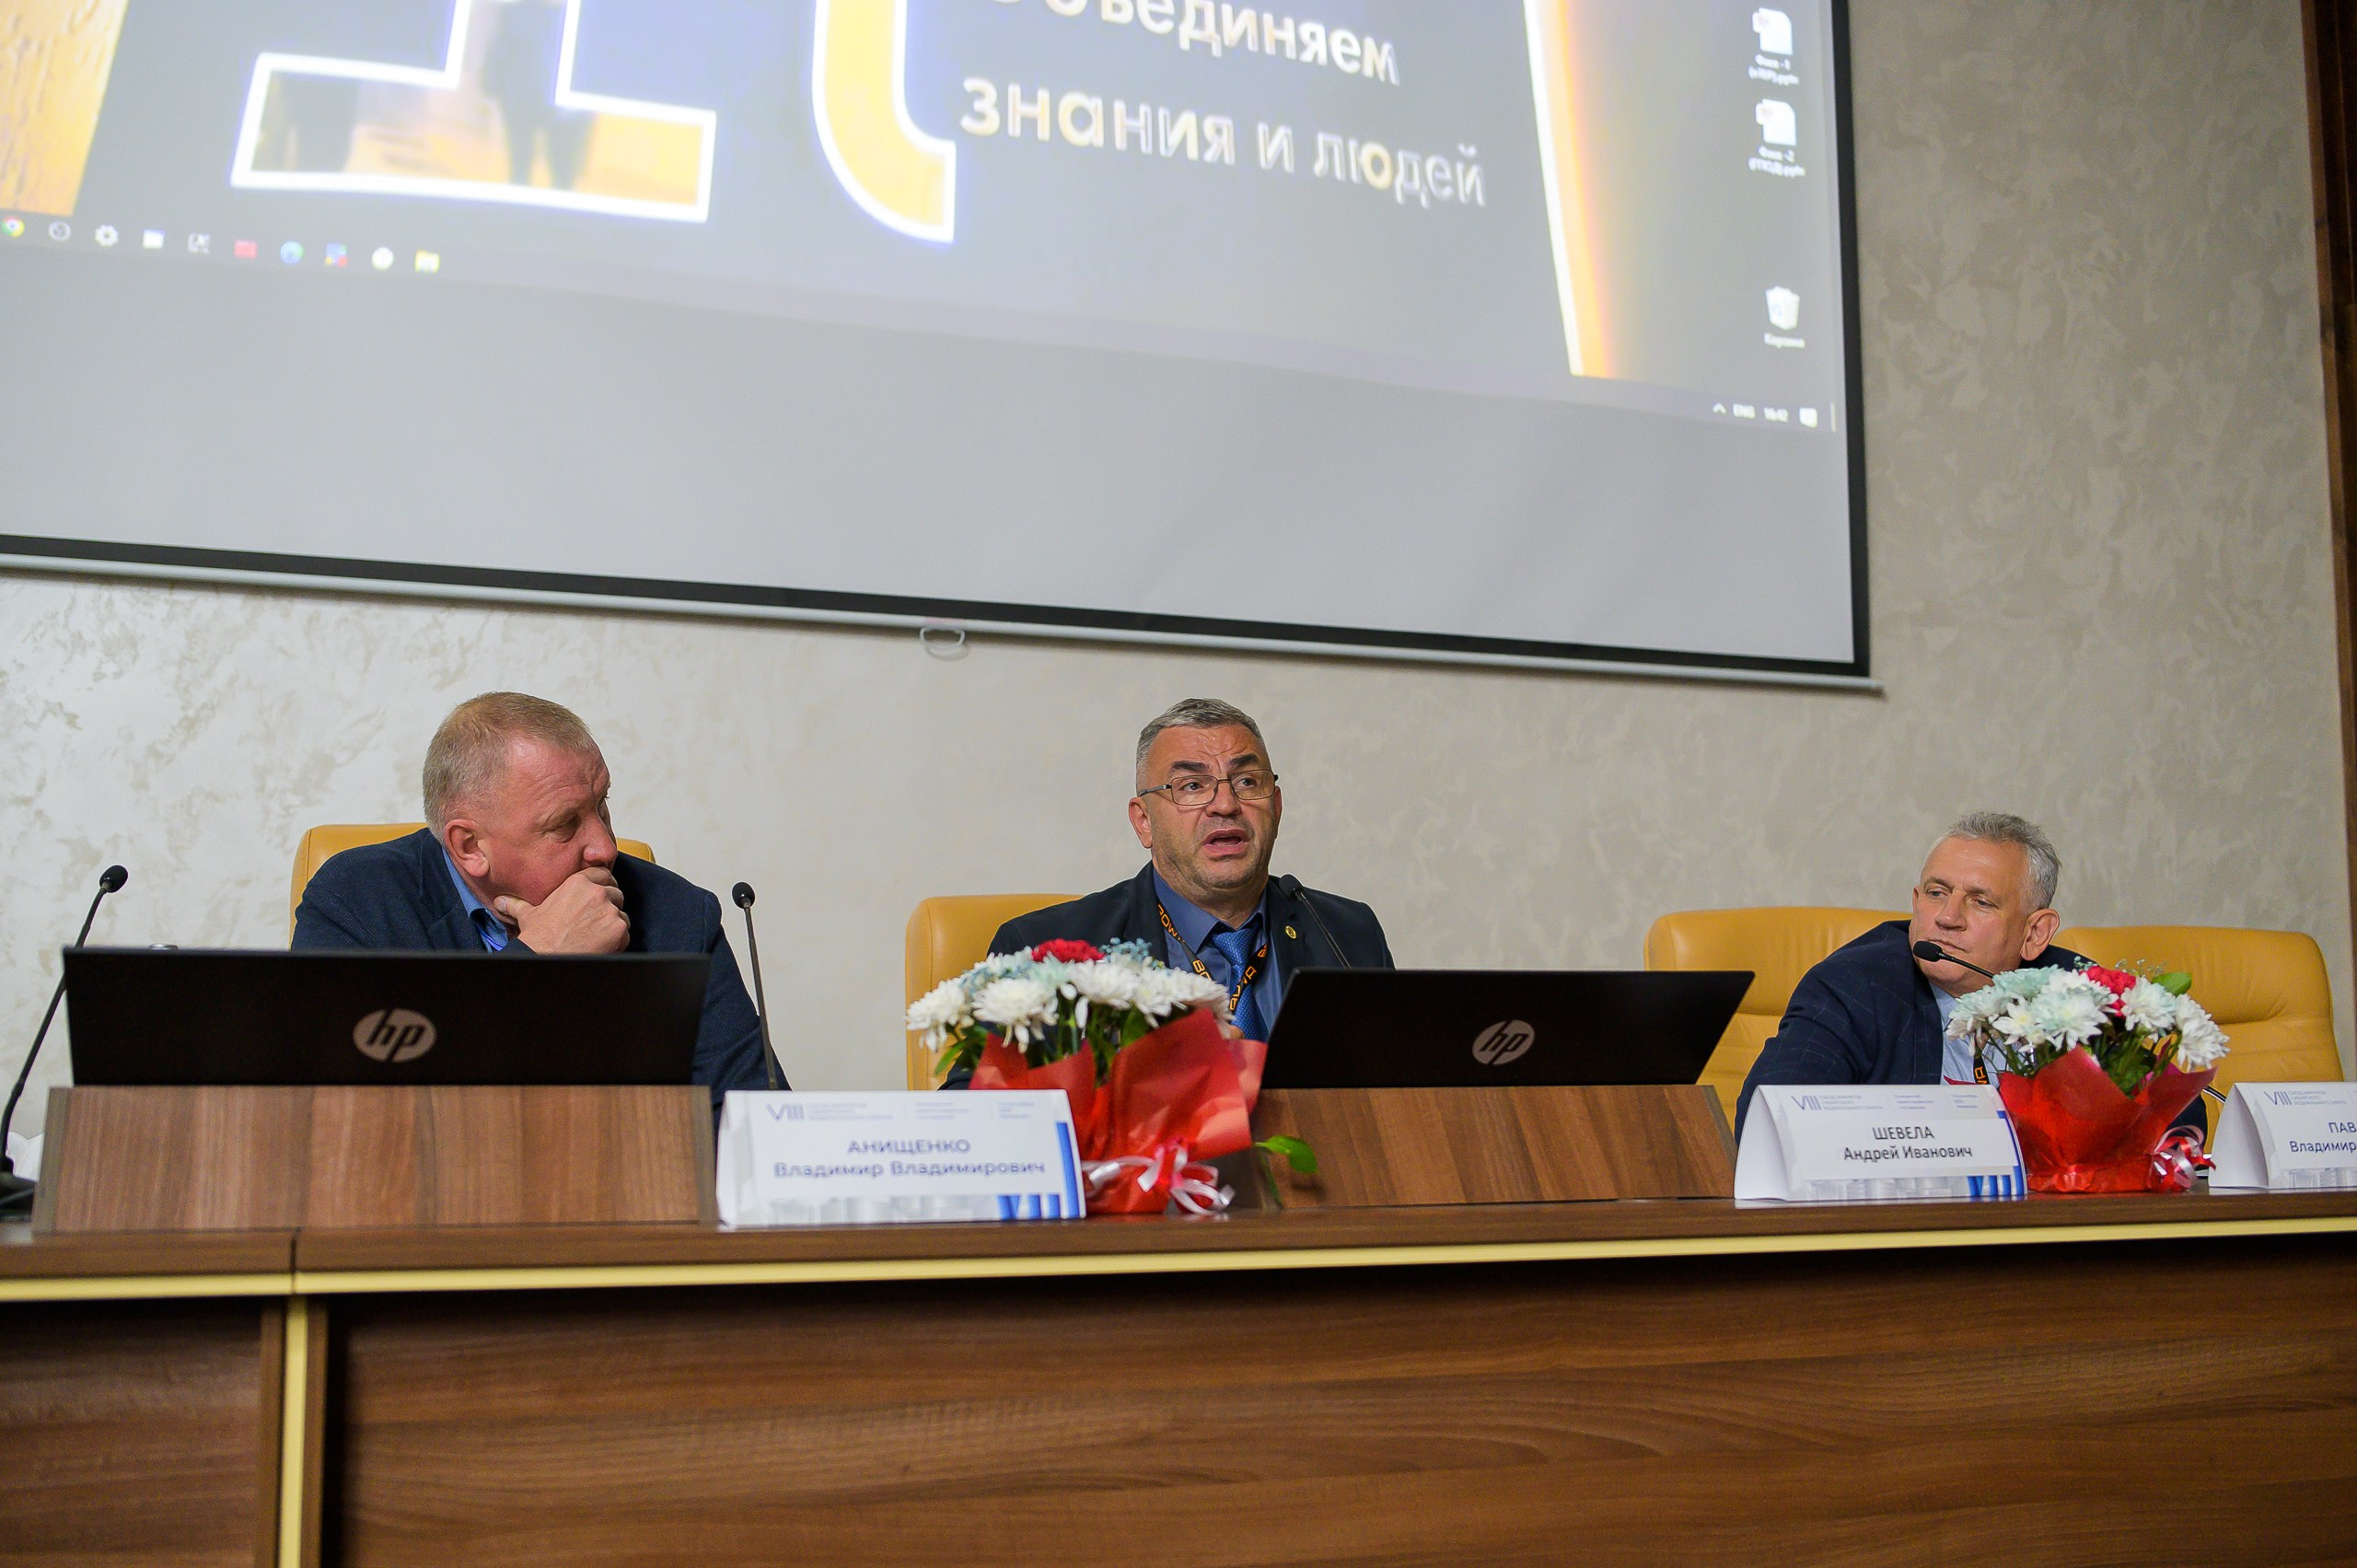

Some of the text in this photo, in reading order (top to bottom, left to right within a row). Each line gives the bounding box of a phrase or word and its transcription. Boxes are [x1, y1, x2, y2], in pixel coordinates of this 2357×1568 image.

[993, 0, 1400, 86] ъединяем
[960, 76, 1487, 209] знания и людей
[362, 1008, 429, 1062] hp
[1476, 1019, 1530, 1064] hp
[766, 1103, 805, 1121] VIII
[1872, 1126, 1935, 1140] ШЕВЕЛА
[2328, 1121, 2357, 1133] ПАВ
[847, 1138, 971, 1156] АНИЩЕНКО
[1843, 1144, 1973, 1163] Андрей Иванович
[2289, 1140, 2357, 1154] Владимир
[773, 1159, 1046, 1179] Владимир Владимирович
